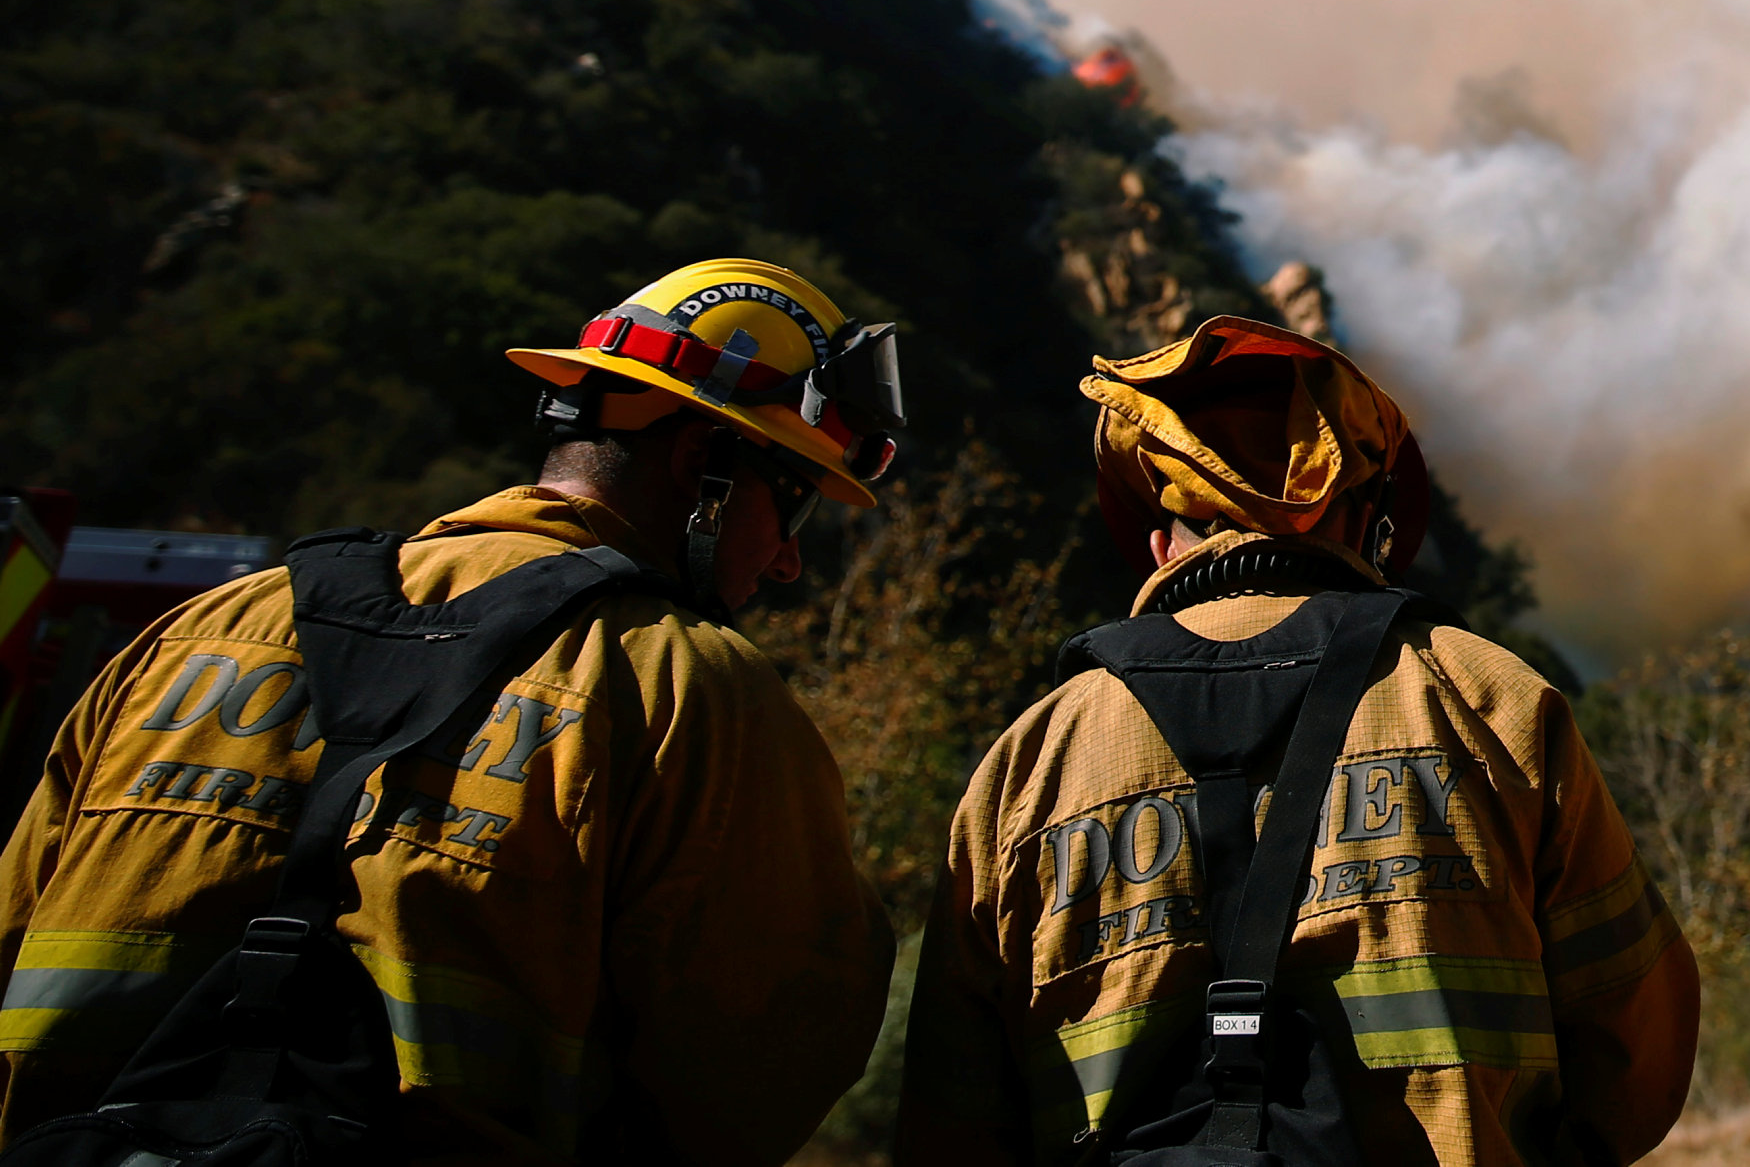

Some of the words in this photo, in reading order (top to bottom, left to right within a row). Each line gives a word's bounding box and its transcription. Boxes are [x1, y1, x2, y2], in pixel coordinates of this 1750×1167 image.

[678, 284, 804, 318] DOWNEY
[141, 652, 583, 783] DOEY
[352, 789, 513, 853] EPT.
[1048, 755, 1463, 916] DOEY
[1077, 894, 1212, 962] FIR
[1215, 1019, 1238, 1031] BOX
